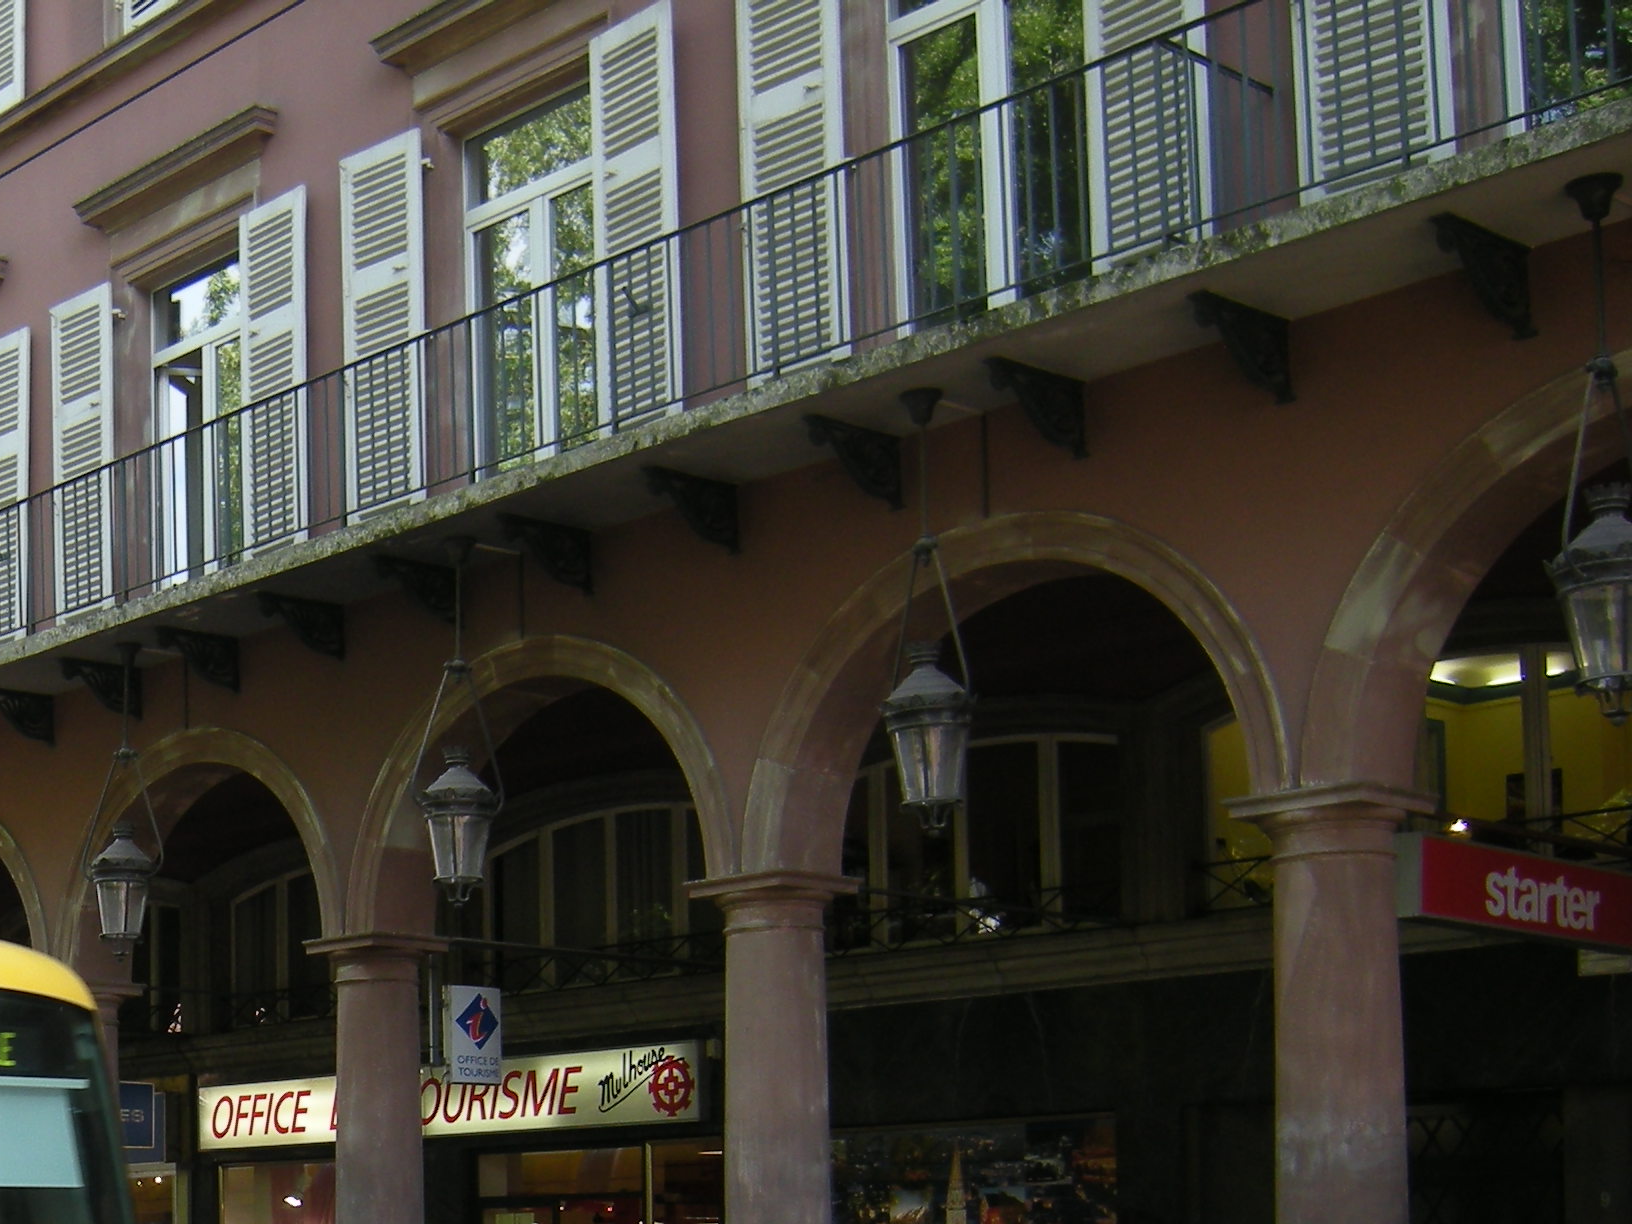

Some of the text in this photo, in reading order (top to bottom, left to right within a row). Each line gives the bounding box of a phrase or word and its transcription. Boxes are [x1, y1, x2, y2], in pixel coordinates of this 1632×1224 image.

[1485, 866, 1600, 931] starter
[457, 1055, 499, 1066] OFFICE DE
[458, 1066, 499, 1078] TOURISME
[598, 1046, 668, 1112] Mulhouse
[212, 1090, 311, 1139] OFFICE
[420, 1066, 583, 1126] OURISME
